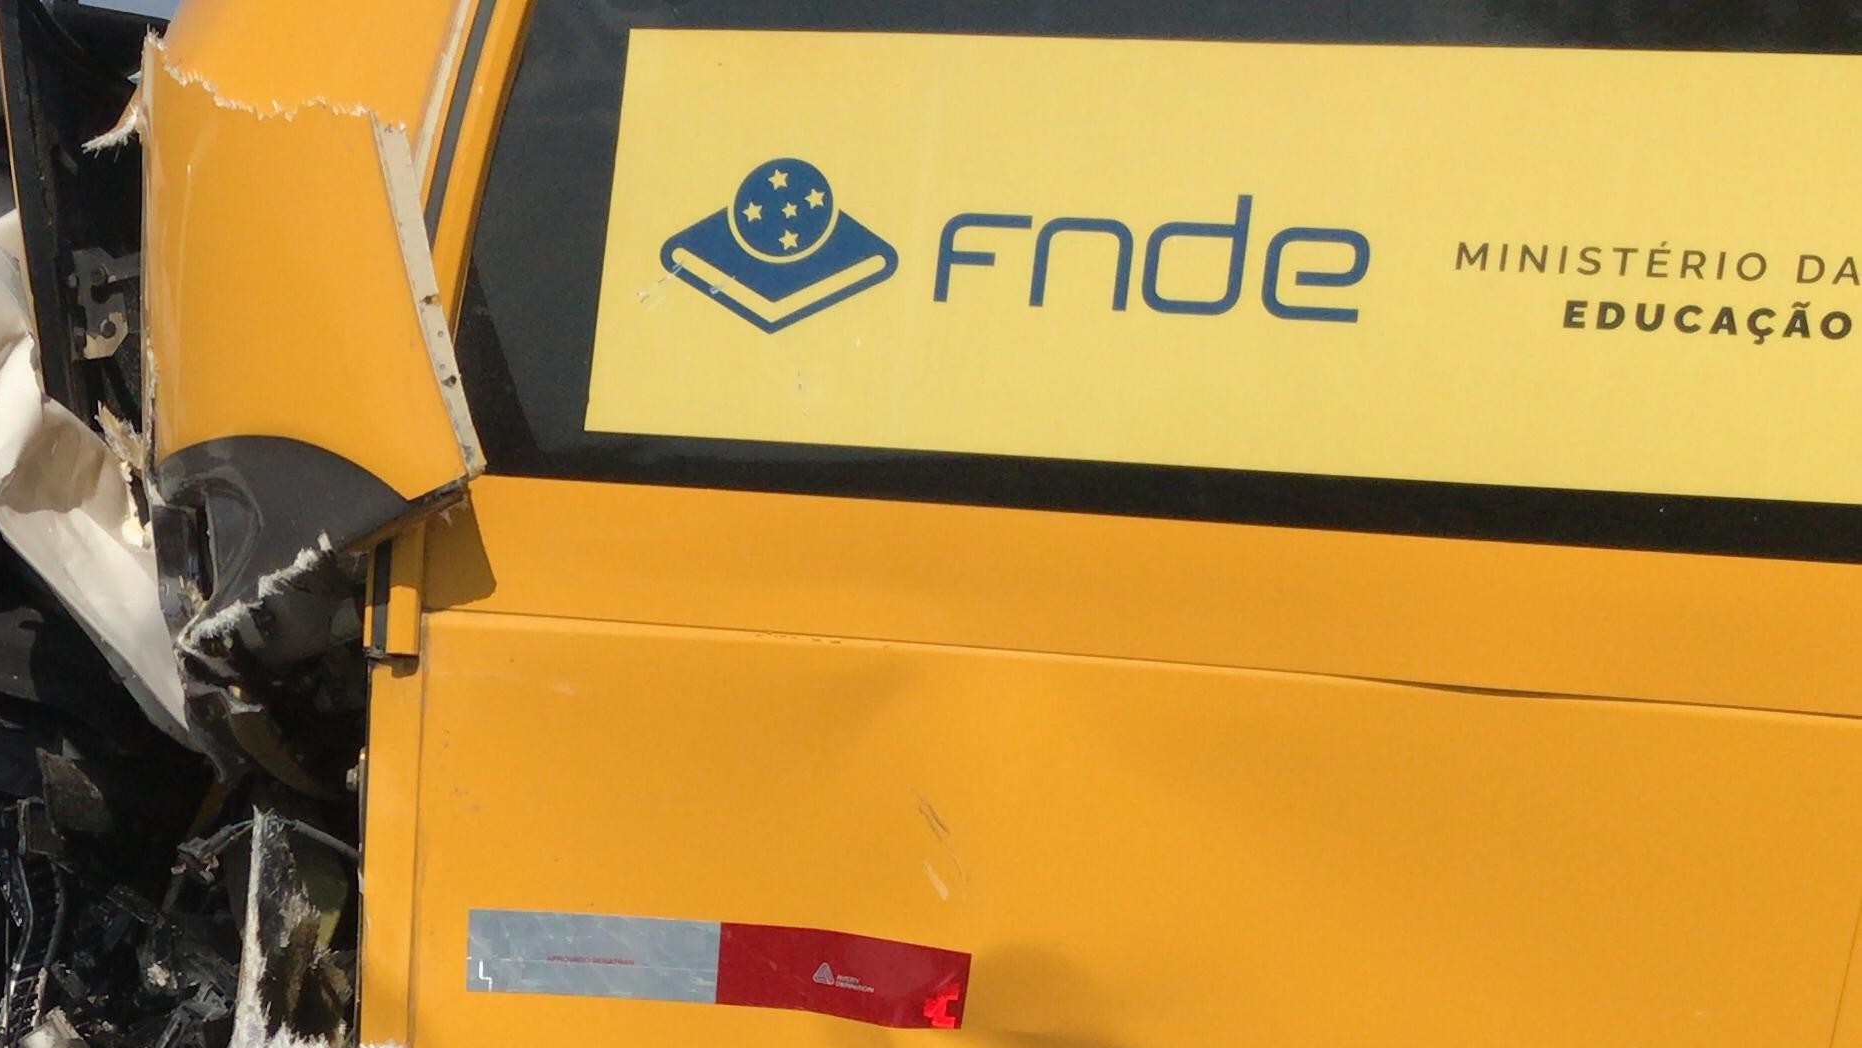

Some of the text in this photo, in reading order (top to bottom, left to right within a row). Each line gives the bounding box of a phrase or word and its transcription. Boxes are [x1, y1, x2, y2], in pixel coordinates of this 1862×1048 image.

[1455, 241, 1862, 286] MINISTÉRIO DA
[1562, 299, 1853, 346] EDUCAÇÃO
